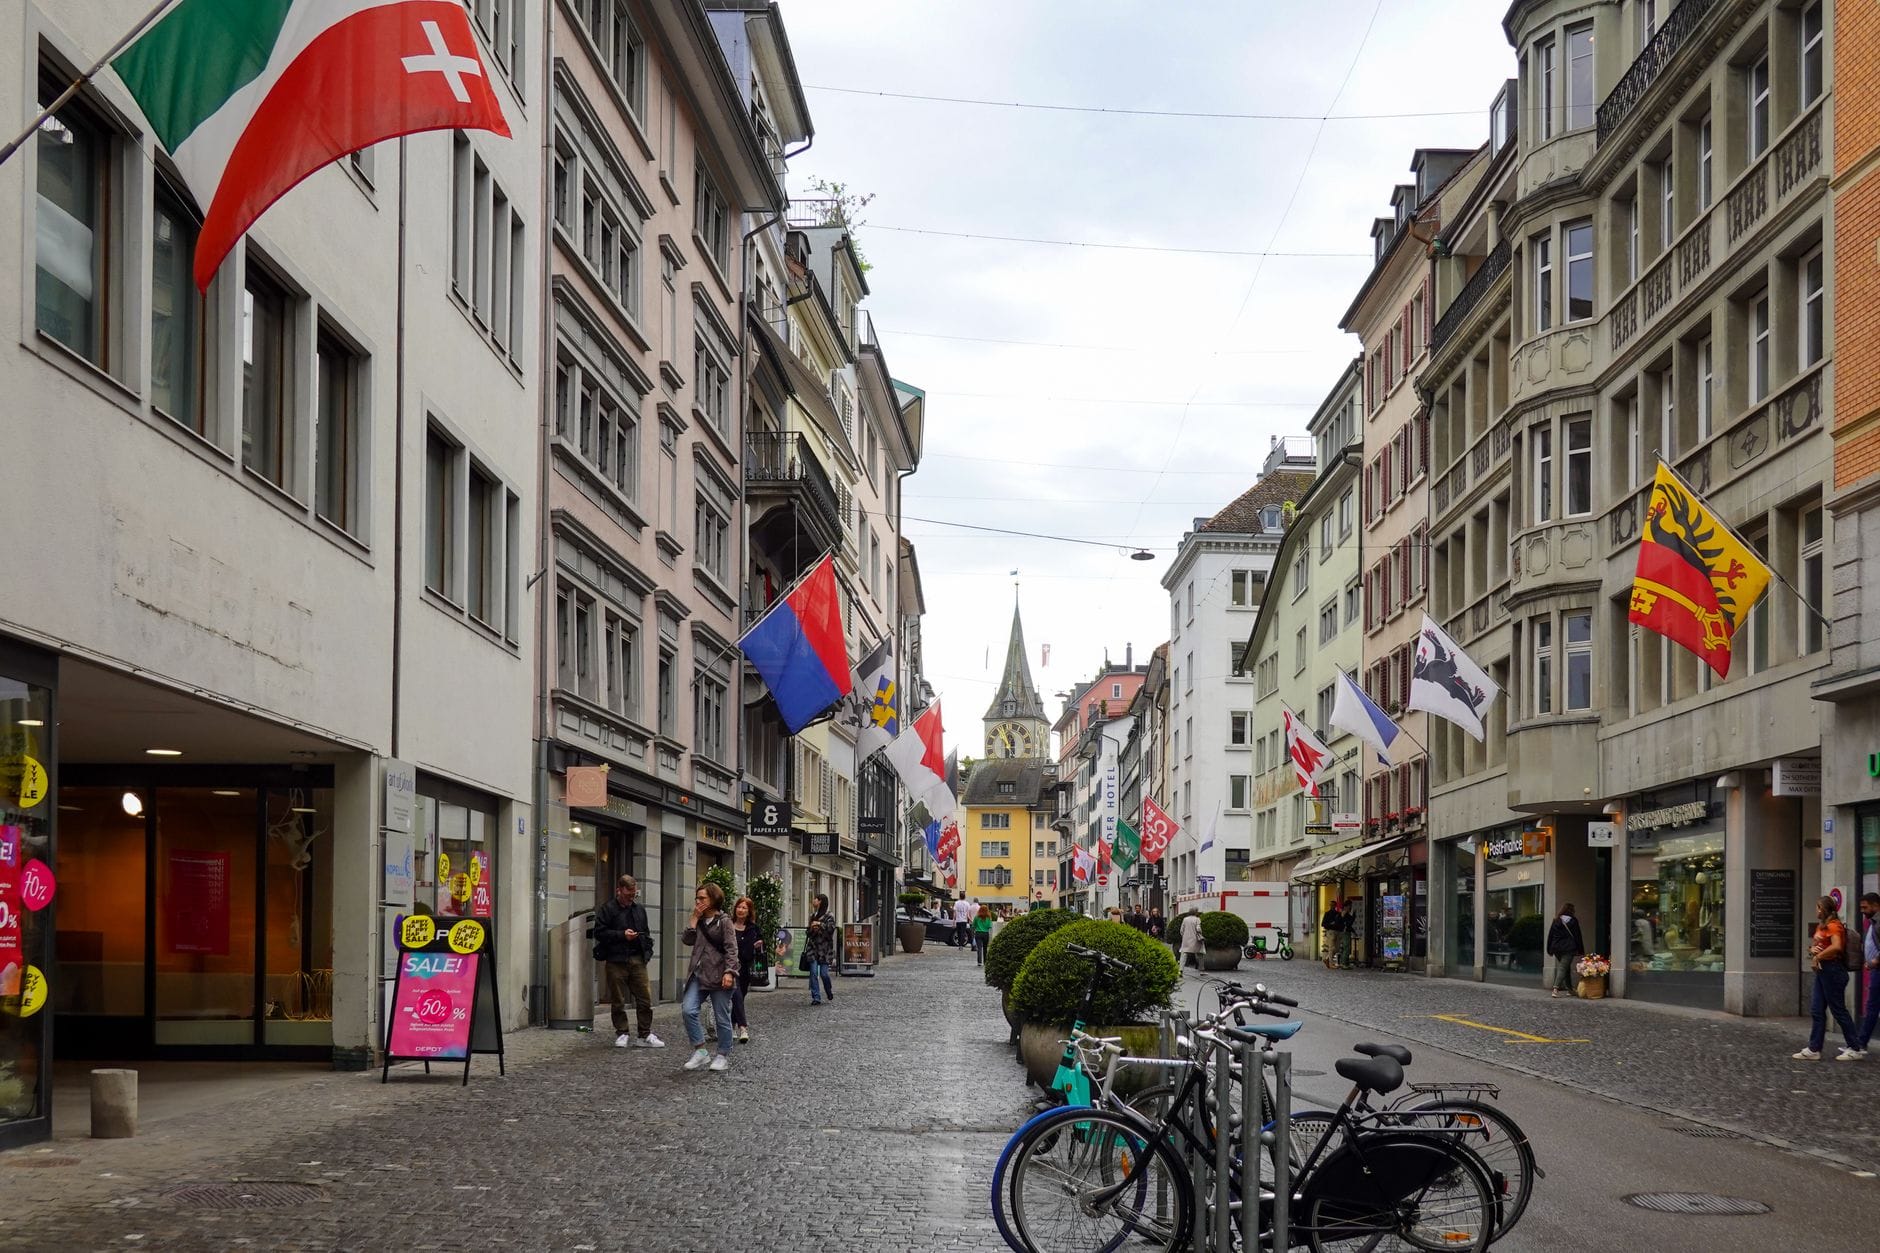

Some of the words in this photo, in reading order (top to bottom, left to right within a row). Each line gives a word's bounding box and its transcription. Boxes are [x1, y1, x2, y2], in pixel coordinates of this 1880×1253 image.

[1107, 766, 1115, 808] HOTEL
[1489, 839, 1523, 857] PostFinance
[23, 871, 48, 901] 70%
[453, 940, 475, 950] SALE
[404, 957, 463, 973] SALE!
[420, 998, 447, 1017] 50%
